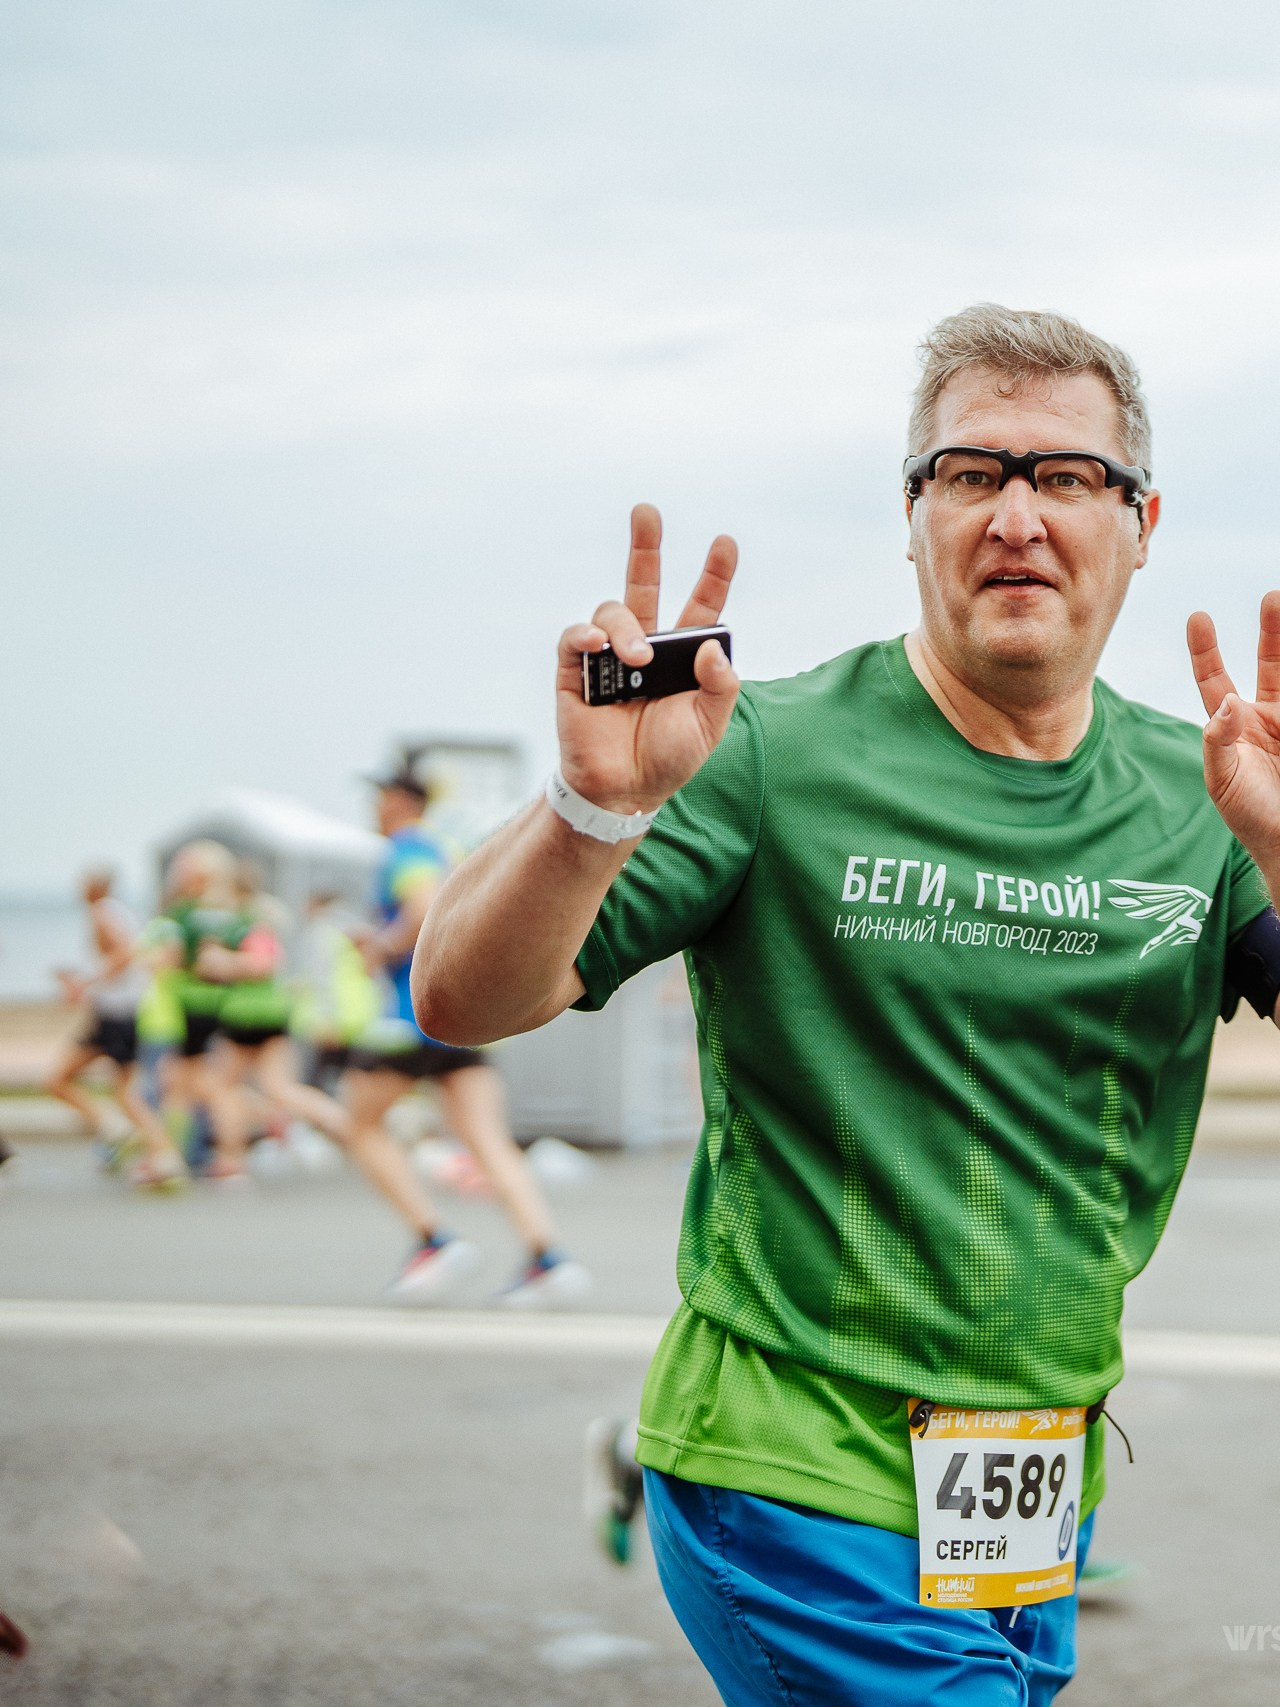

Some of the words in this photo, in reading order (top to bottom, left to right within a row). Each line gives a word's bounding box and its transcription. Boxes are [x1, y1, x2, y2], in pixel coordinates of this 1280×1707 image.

[840, 855, 956, 916] БЕГИ,
[974, 871, 1100, 920] ГЕРОЙ!
[834, 914, 936, 943] НИЖНИЙ
[942, 920, 1051, 955] НОВГОРОД
[1053, 930, 1098, 955] 2023
[929, 1412, 970, 1431] БЕГИ,
[974, 1410, 1020, 1429] ГЕРОЙ!
[936, 1452, 1066, 1520] 4589
[936, 1535, 1008, 1561] СЕРГЕЙ
